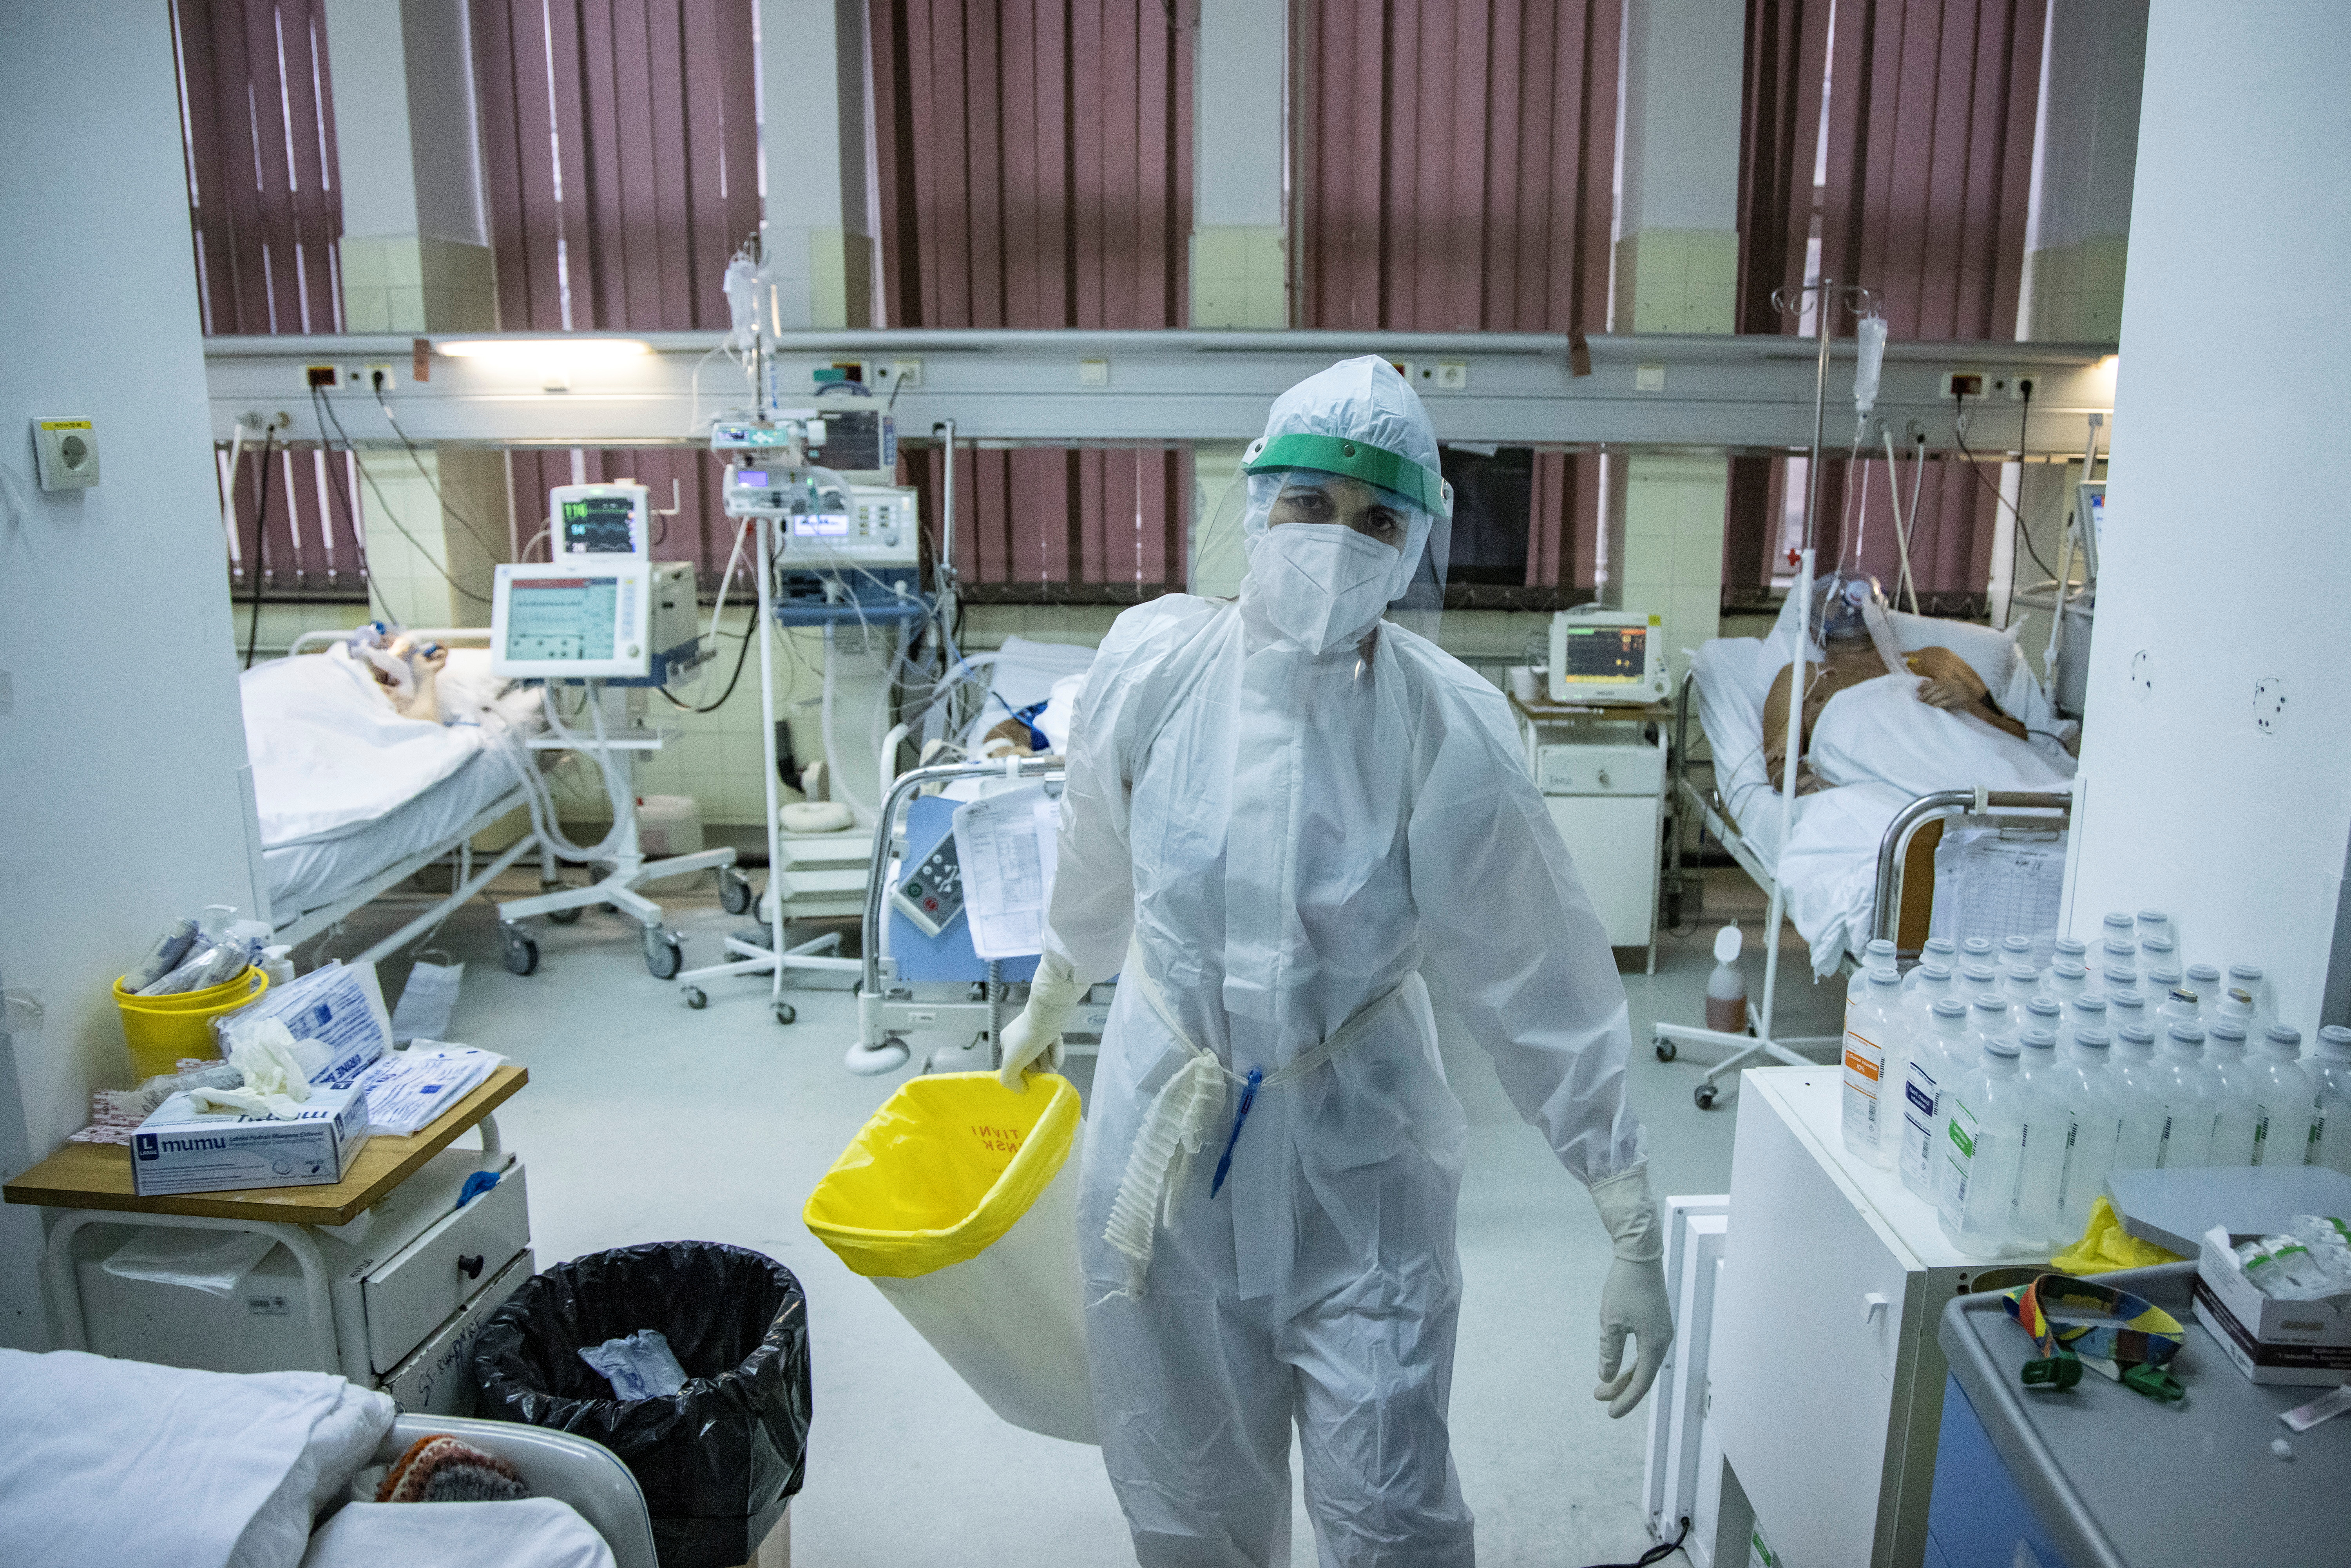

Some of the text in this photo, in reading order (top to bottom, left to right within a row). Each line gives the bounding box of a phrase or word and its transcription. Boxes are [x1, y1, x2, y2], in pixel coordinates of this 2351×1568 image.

[1849, 1054, 1878, 1072] Glucosi infundibile
[1856, 1064, 1865, 1073] 10%
[1909, 1086, 1930, 1106] Natrii chloridi
[1911, 1095, 1927, 1110] infundibile
[143, 1139, 152, 1150] L
[162, 1137, 226, 1153] mumu
